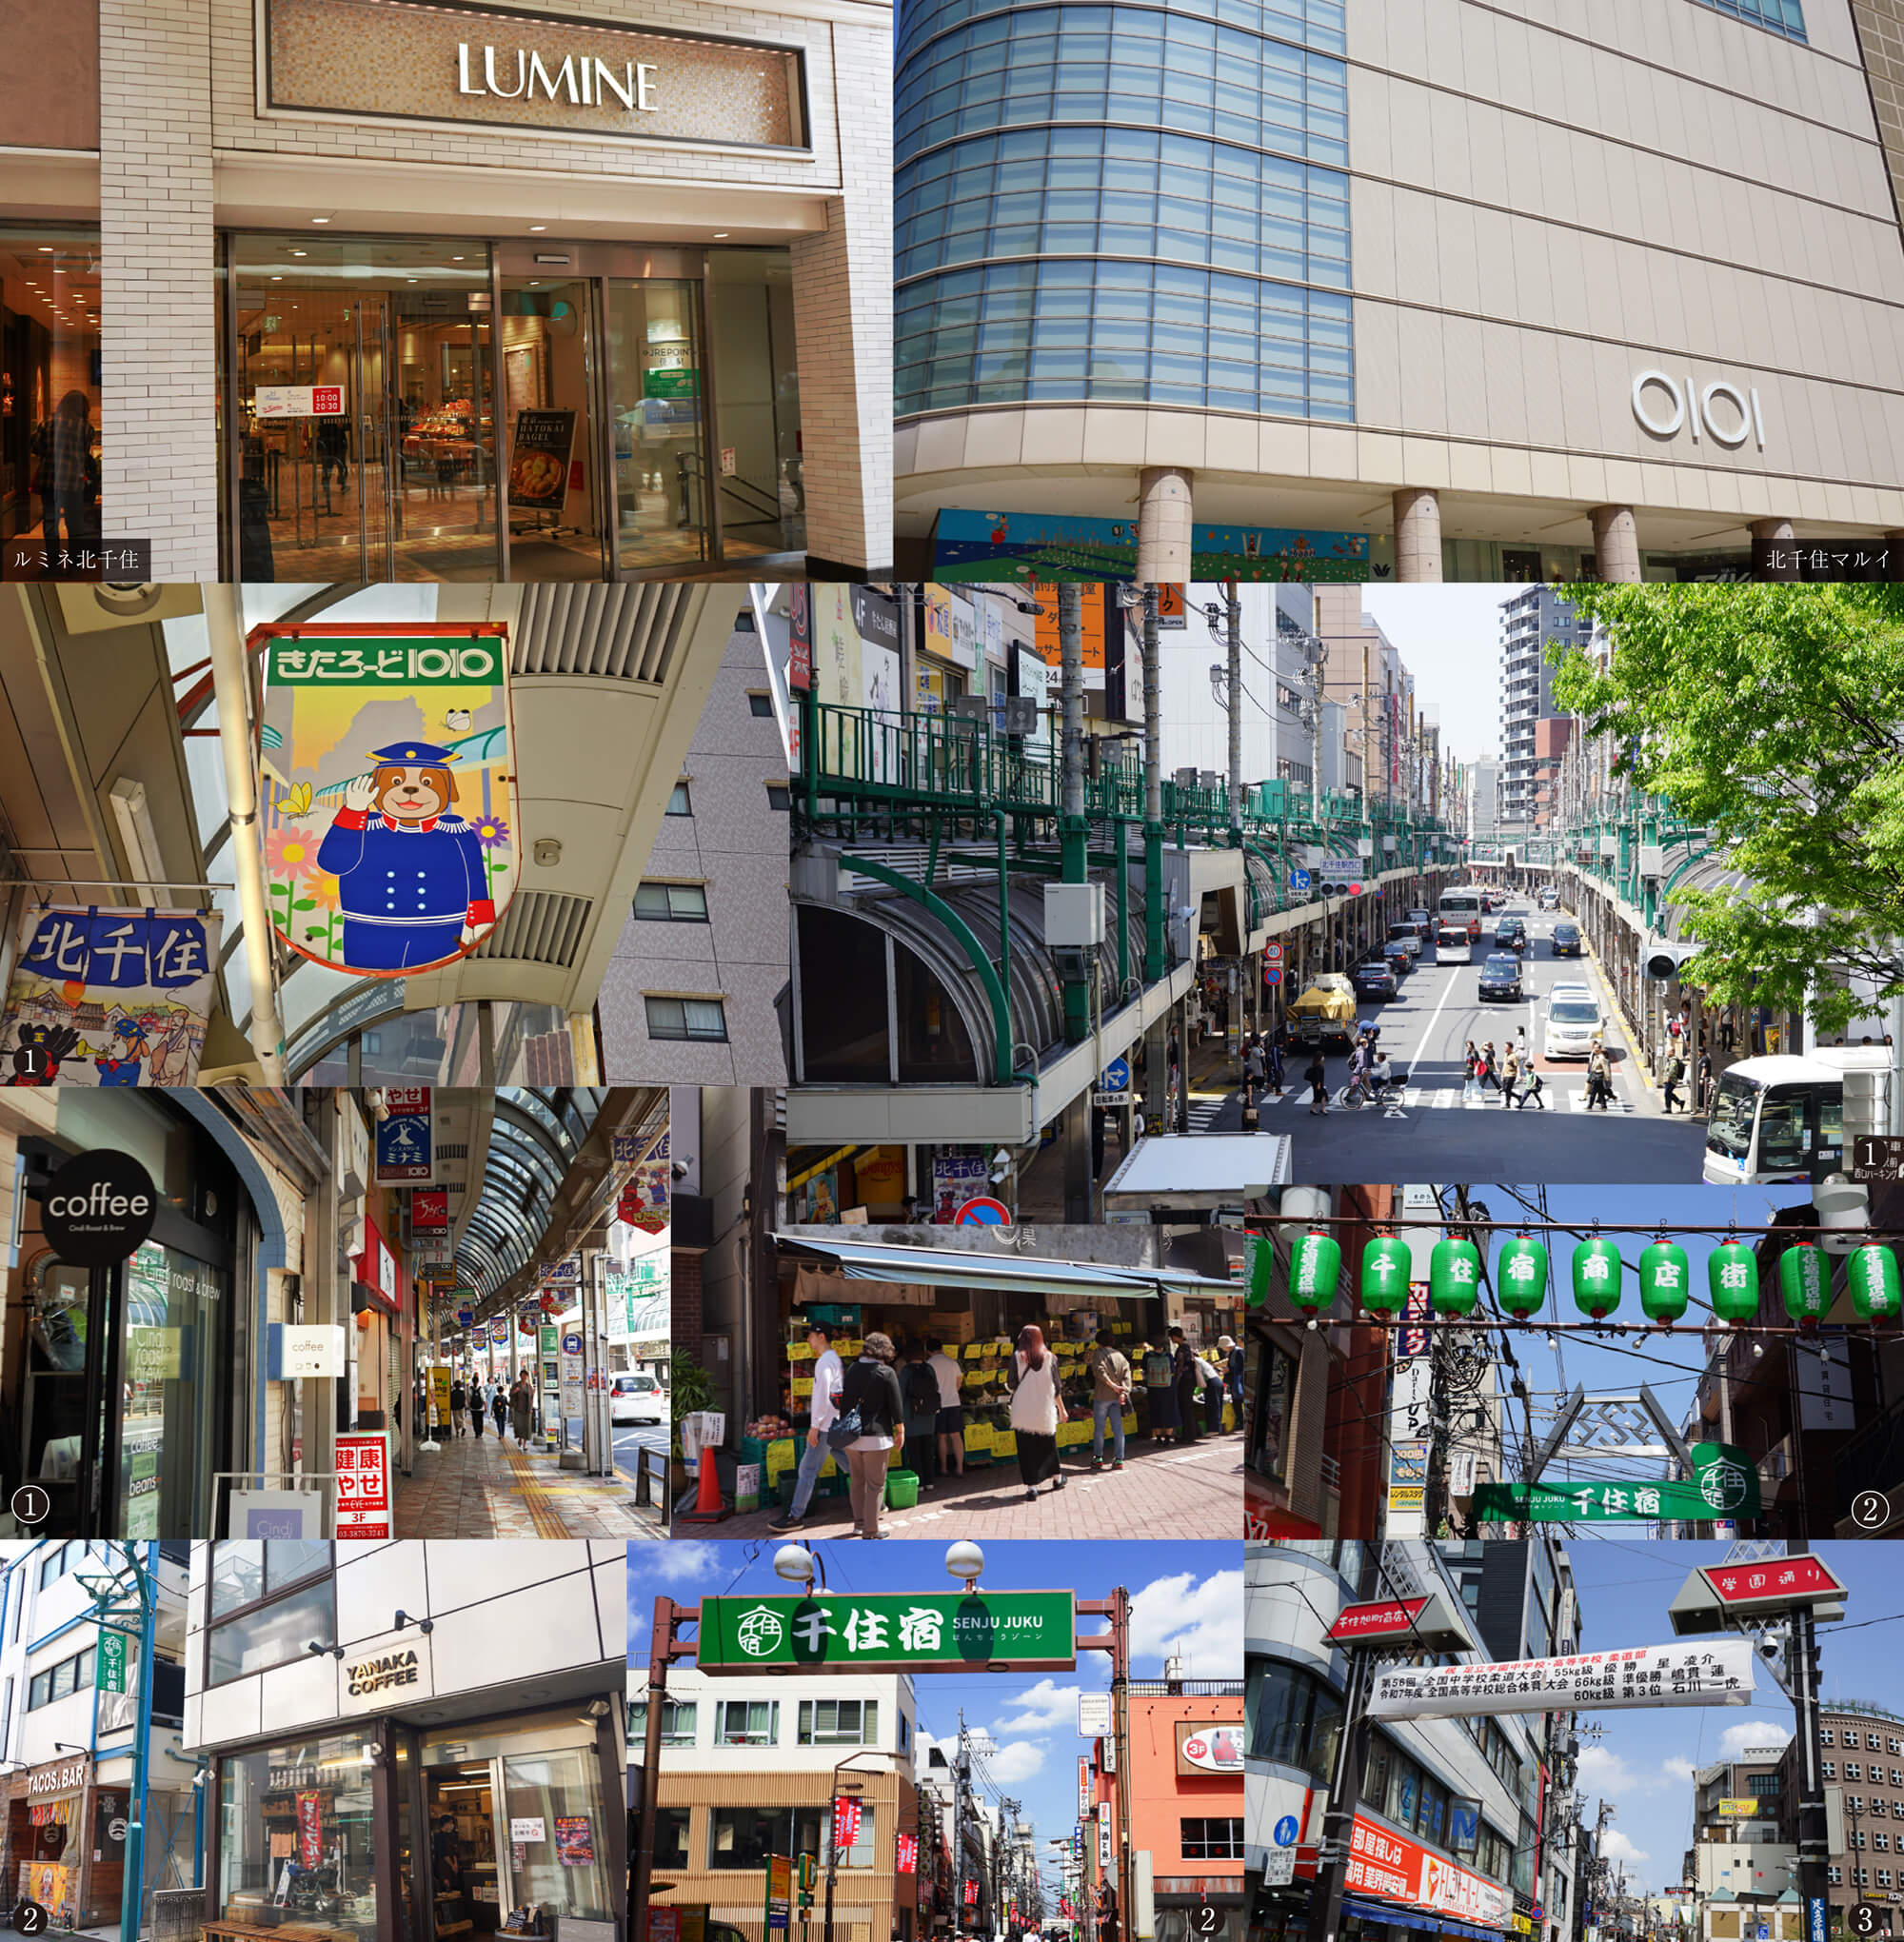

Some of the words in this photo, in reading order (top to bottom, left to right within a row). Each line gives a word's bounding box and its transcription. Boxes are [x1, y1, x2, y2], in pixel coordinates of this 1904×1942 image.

[457, 42, 659, 112] LUMINE
[518, 433, 549, 442] BAGEL
[277, 649, 494, 679] きたろーど1010
[1321, 860, 1361, 869] 北千住駅西口
[37, 921, 204, 982] 北千住
[1269, 946, 1279, 956] 40
[386, 1151, 425, 1164] ミナミ
[937, 1158, 986, 1177] 北千住
[49, 1182, 149, 1218] coffee
[172, 1272, 195, 1293] roast
[202, 1274, 221, 1300] brew
[292, 1341, 324, 1353] coffee
[335, 1448, 381, 1470] 健康
[129, 1474, 157, 1496] beans
[338, 1474, 381, 1496] やせ
[1515, 1496, 1541, 1504] SENJU
[1570, 1487, 1661, 1516] 千住宿
[257, 1520, 292, 1536] Cindi
[351, 1512, 366, 1523] 3F
[1722, 1569, 1820, 1592] 学園通り
[791, 1605, 944, 1653] 千住宿
[953, 1615, 1000, 1631] SENJU
[1003, 1615, 1043, 1629] JUKU
[346, 1650, 419, 1681] YANAKA
[1424, 1670, 1543, 1687] 全国中学校柔道大会
[1555, 1665, 1594, 1676] 55kg級
[1604, 1661, 1636, 1674] 優勝
[1656, 1657, 1670, 1669] 星
[1683, 1653, 1715, 1666] 凌介
[1462, 1655, 1602, 1674] 足立学園中学校・高等学校
[1608, 1650, 1647, 1662] 柔道部
[107, 1658, 117, 1692] 千住宿
[347, 1668, 419, 1696] COFFEE
[1379, 1688, 1424, 1699] 令和7年度
[1427, 1678, 1569, 1698] 全国高等学校総合体育大会
[1574, 1674, 1616, 1688] 66kg級
[1622, 1670, 1662, 1685] 準優勝
[1671, 1666, 1700, 1681] 嶋貫
[1574, 1686, 1616, 1701] 60kg級
[1622, 1683, 1662, 1699] 第3位
[1671, 1679, 1701, 1694] 石川
[1710, 1676, 1741, 1690] 一虎
[1188, 1742, 1206, 1755] 3F
[1352, 1826, 1403, 1866] 部屋探しは
